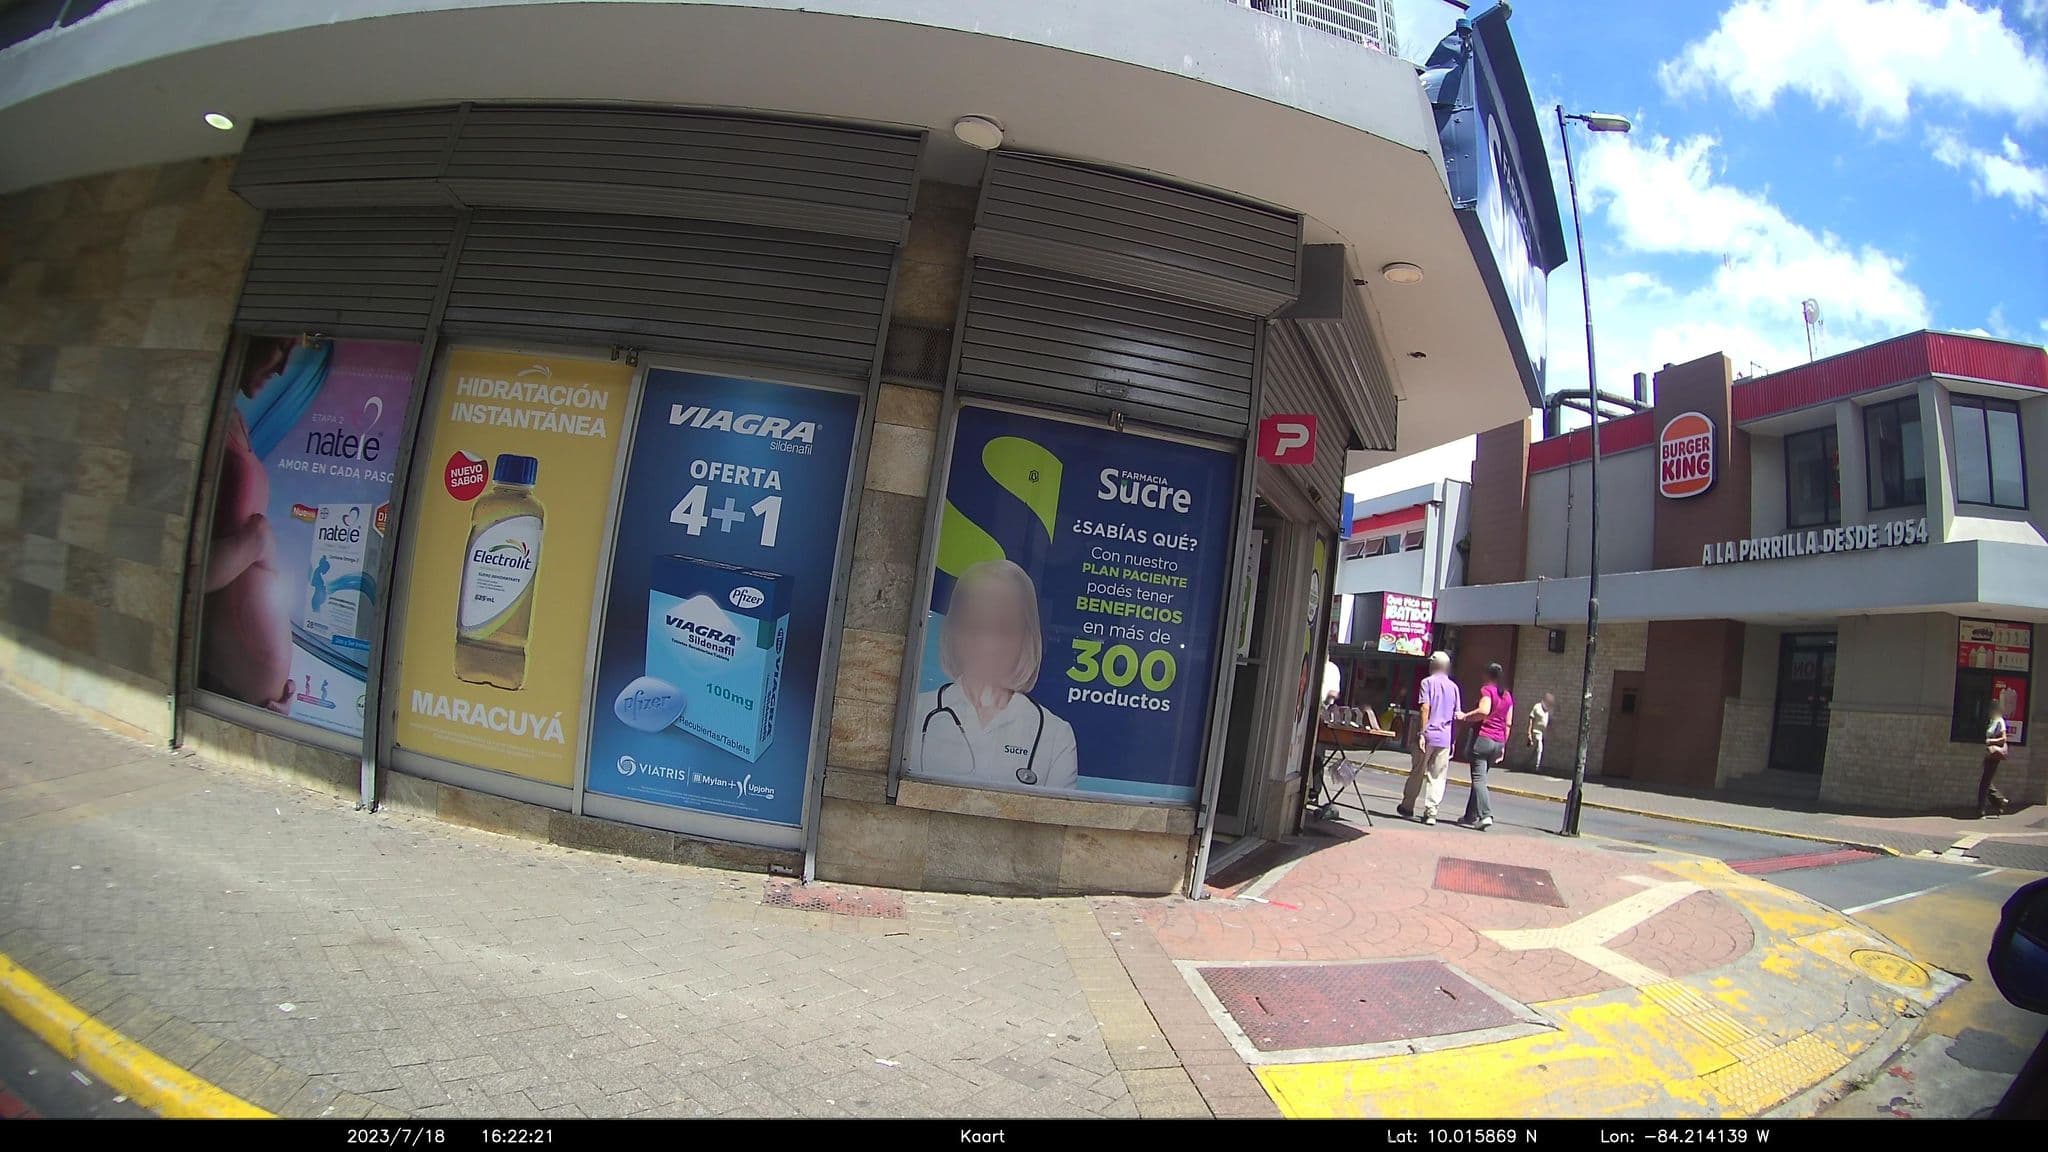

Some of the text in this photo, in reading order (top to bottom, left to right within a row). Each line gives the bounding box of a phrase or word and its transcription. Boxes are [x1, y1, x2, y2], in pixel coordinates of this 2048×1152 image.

[456, 376, 609, 411] HIDRATACIÓN
[311, 413, 345, 425] ETAPA 2
[450, 402, 607, 438] INSTANTÁNEA
[669, 403, 817, 444] VIAGRA
[305, 428, 380, 462] natele
[769, 440, 814, 455] sildenafil
[1662, 436, 1710, 460] BURGER
[278, 458, 309, 472] AMOR
[311, 462, 327, 474] EN
[329, 465, 361, 480] CADA
[450, 464, 483, 478] NUEVO
[450, 473, 484, 488] SABOR
[689, 459, 782, 491] OFERTA
[1121, 470, 1169, 486] FARMACIA
[1662, 453, 1711, 483] KING
[1097, 467, 1192, 513] Sucre
[669, 484, 783, 547] 4+1
[318, 525, 360, 543] natele
[1072, 519, 1198, 552] ¿SABÍAS QUÉ?
[1702, 517, 1929, 566] A LA PARRILLA DESDE 1954
[473, 549, 532, 570] Electrolit
[1091, 546, 1179, 572] Con nuestro
[1082, 562, 1189, 588] PLAN PACIENTE
[732, 589, 764, 608] Pfizer
[1086, 582, 1174, 604] podés tener
[1076, 595, 1184, 625] BENEFICIOS
[664, 614, 736, 647] VIAGRA
[1083, 621, 1171, 645] en más de
[688, 633, 736, 657] Sildenafil
[1065, 638, 1177, 692] 300
[706, 683, 754, 711] 100mg
[1067, 686, 1171, 712] productos
[411, 689, 566, 745] MARACUYÁ
[1004, 744, 1029, 756] Sucre
[639, 763, 686, 781] VIATRIS
[702, 775, 728, 787] Mylan
[748, 783, 775, 795] Upjohn
